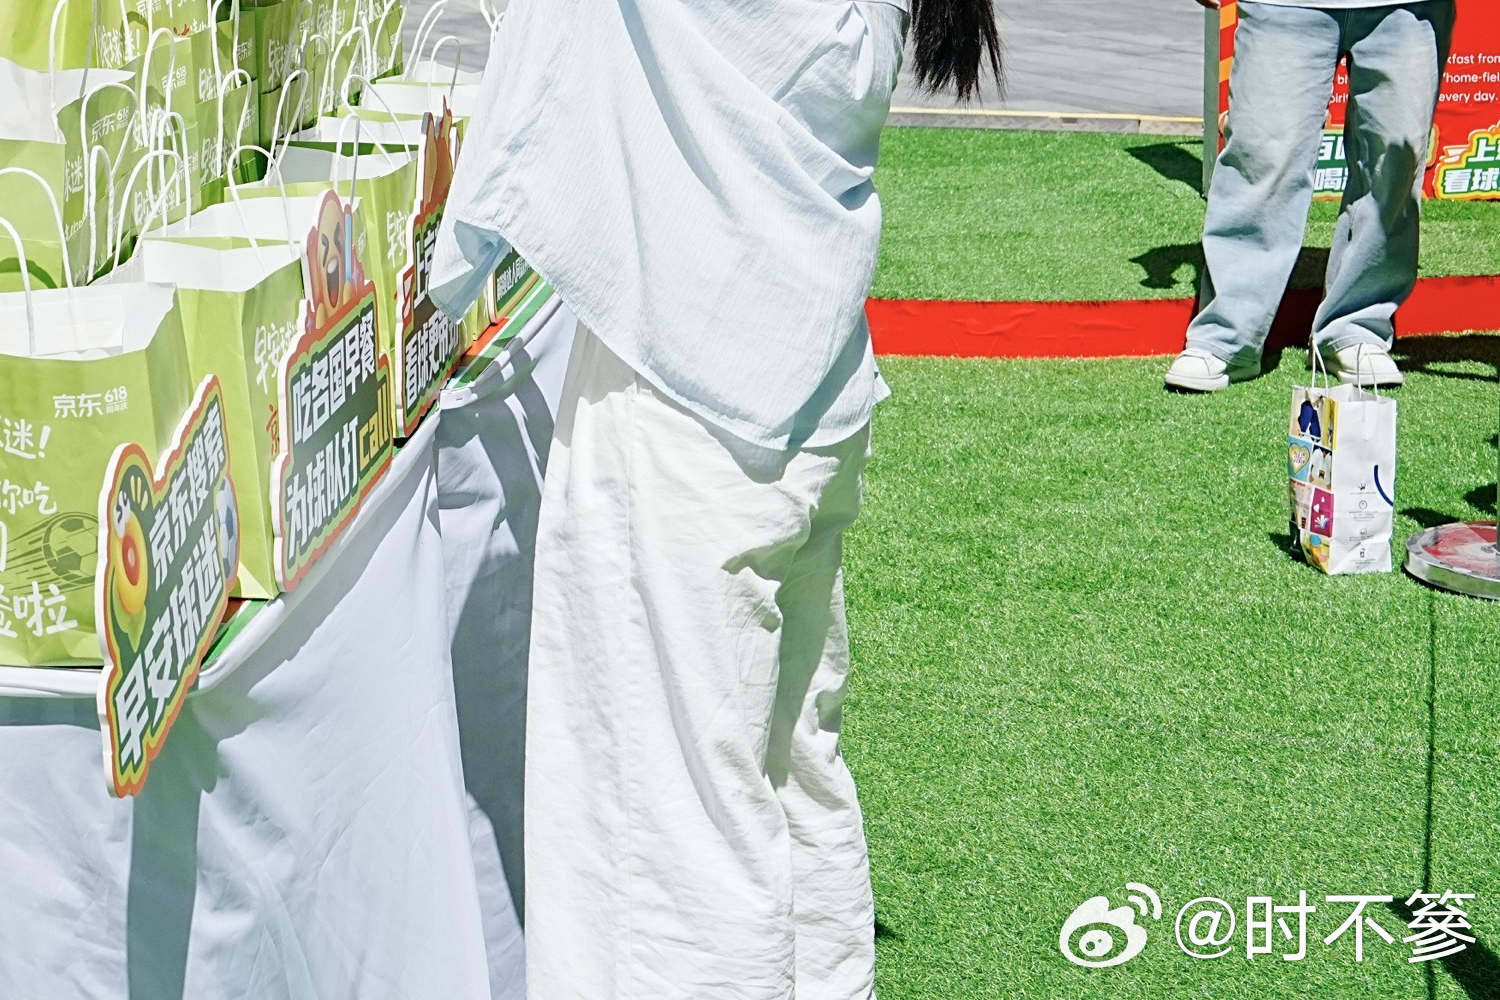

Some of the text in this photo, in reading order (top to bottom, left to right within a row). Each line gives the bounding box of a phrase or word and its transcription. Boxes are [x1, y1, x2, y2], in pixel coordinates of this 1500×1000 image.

[1438, 90, 1499, 104] every day.
[292, 309, 375, 445] 吃各国早餐
[148, 402, 225, 590] 京东搜索
[116, 513, 222, 765] 早安球迷
